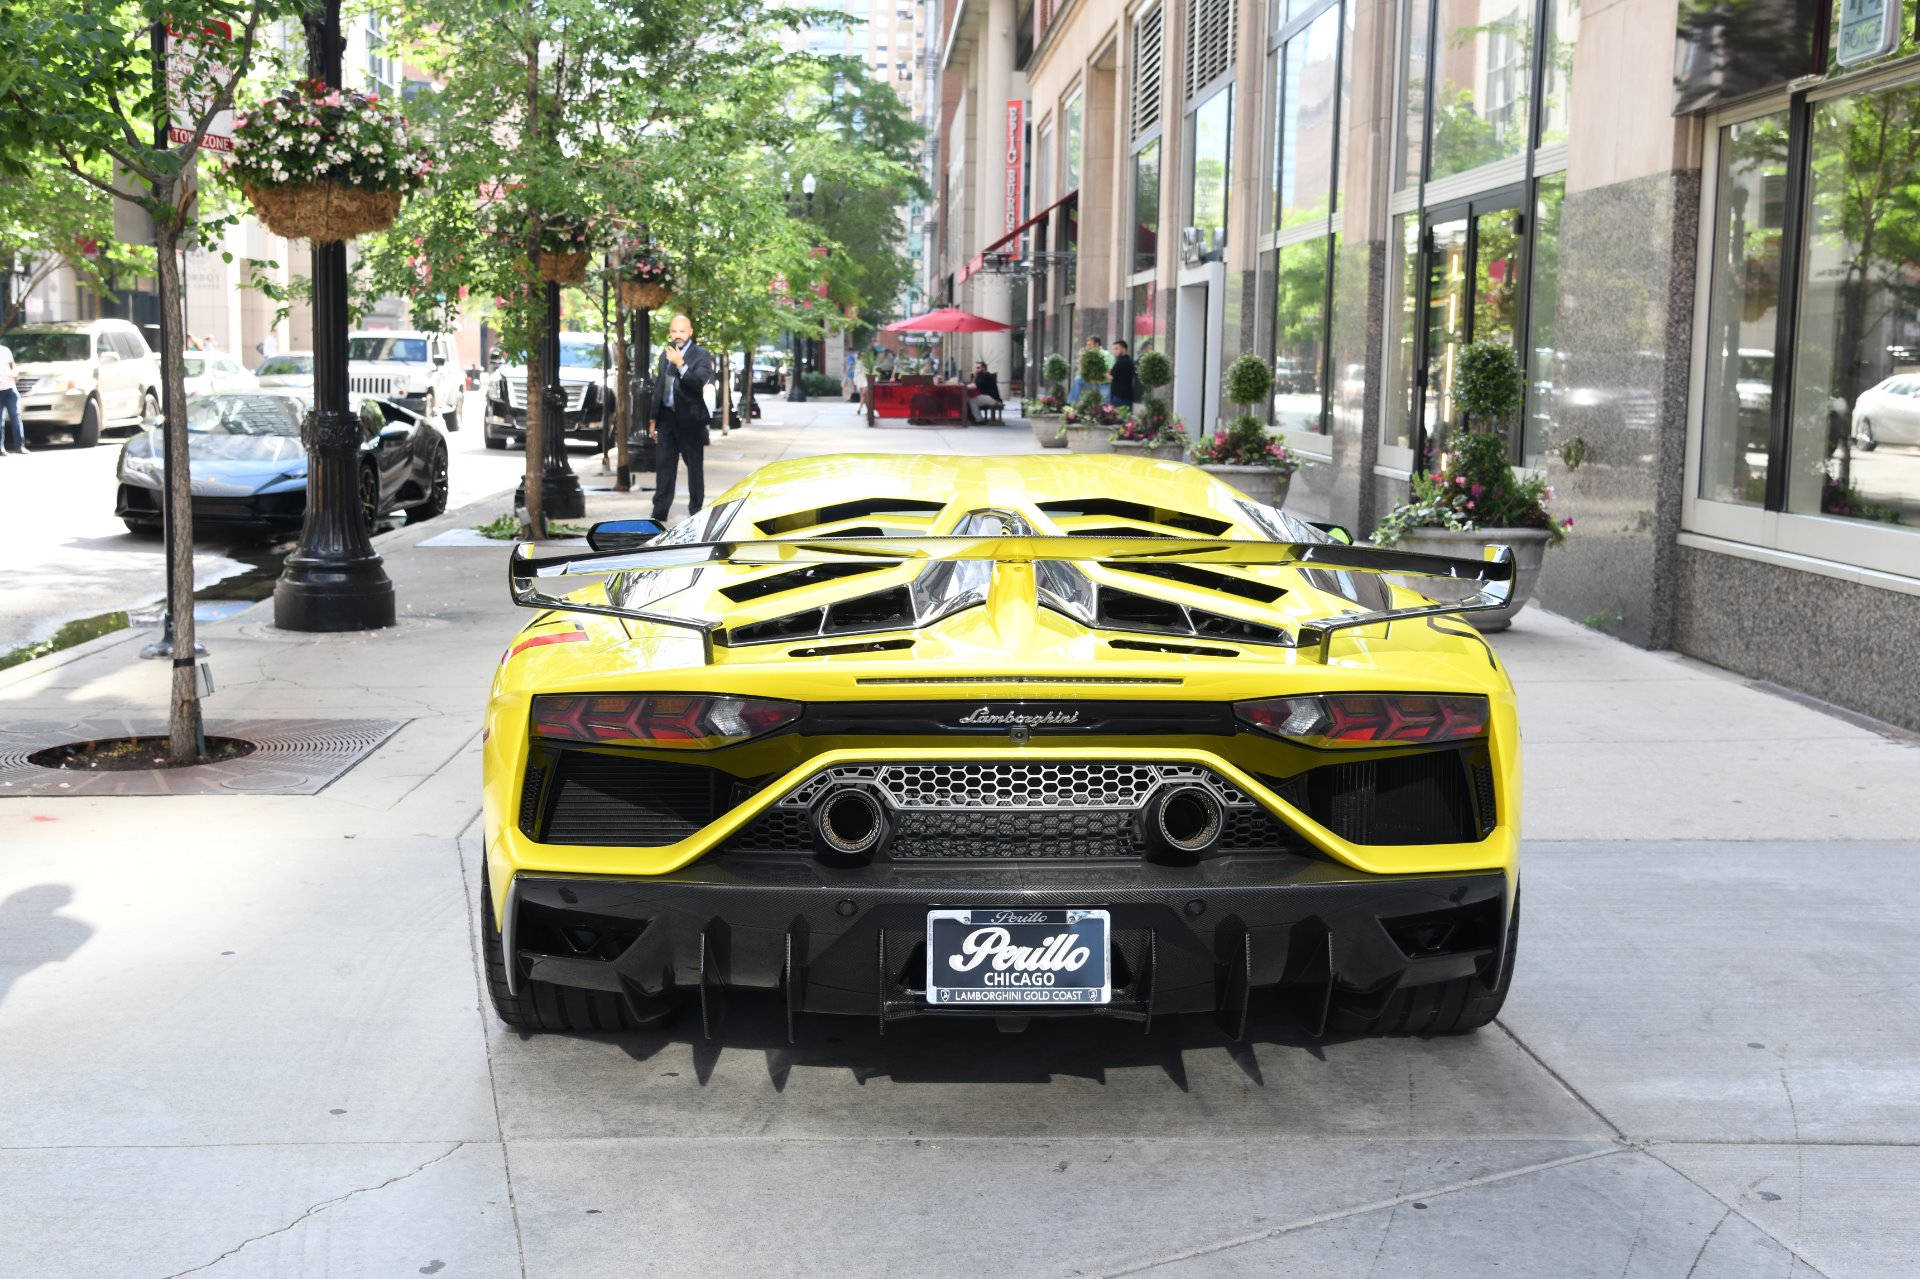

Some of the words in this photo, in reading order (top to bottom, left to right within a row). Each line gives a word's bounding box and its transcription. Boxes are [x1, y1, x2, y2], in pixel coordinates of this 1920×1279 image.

[202, 134, 230, 151] ZONE
[1007, 107, 1017, 164] EPIC
[960, 706, 1079, 727] Lamborghini
[991, 911, 1048, 923] Perillo
[949, 926, 1090, 972] Perillo
[984, 972, 1055, 986] CHICAGO
[955, 991, 1022, 1001] LAMBORGHINI
[1024, 991, 1050, 1001] GOLD
[1053, 991, 1083, 1001] COAST
